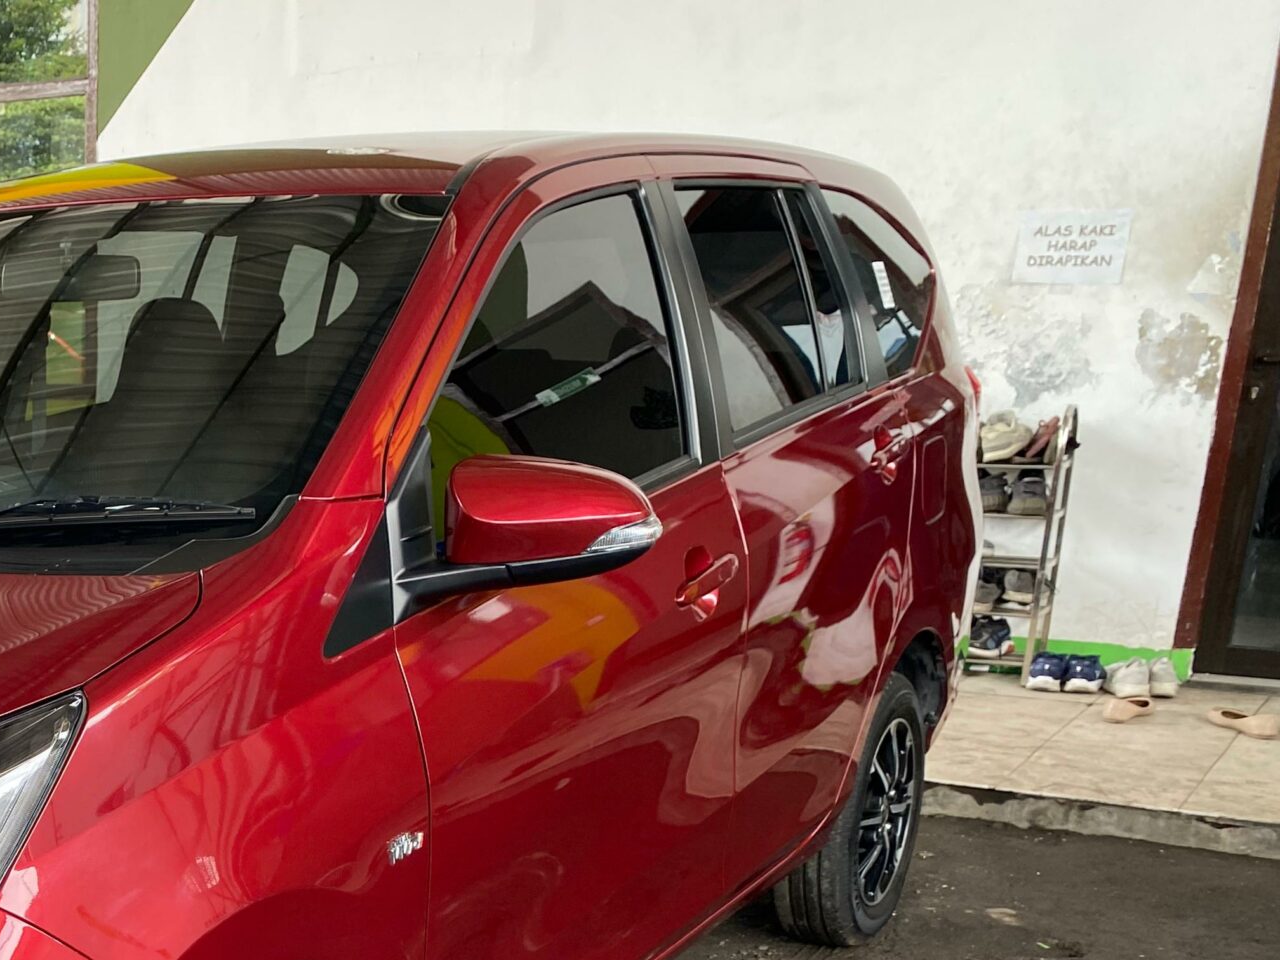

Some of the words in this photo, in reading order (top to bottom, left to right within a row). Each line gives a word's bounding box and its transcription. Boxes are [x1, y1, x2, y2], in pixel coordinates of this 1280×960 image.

[1033, 224, 1074, 238] ALAS
[1078, 224, 1117, 237] KAKI
[1046, 239, 1098, 252] HARAP
[1026, 254, 1113, 267] DIRAPIKAN
